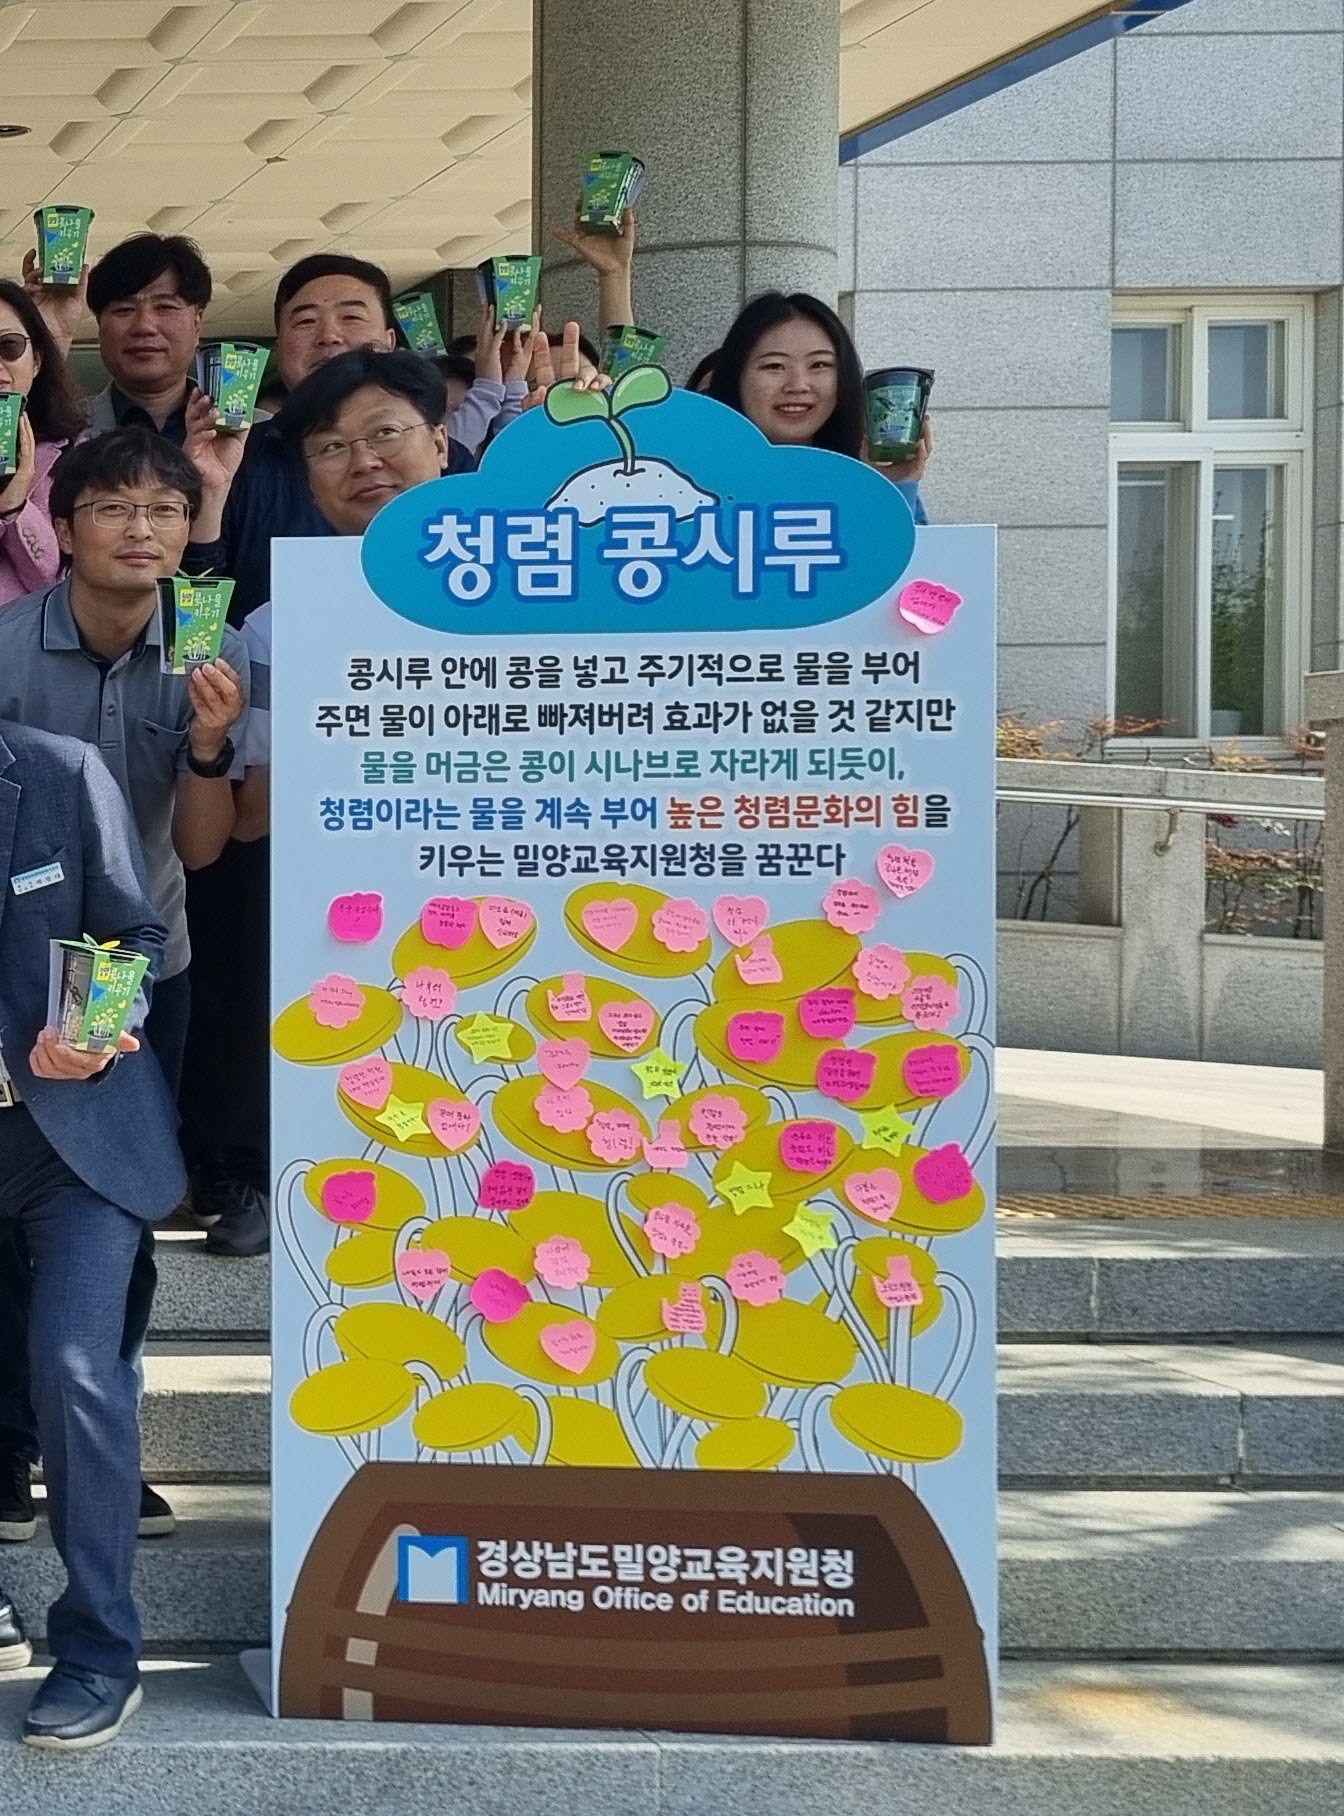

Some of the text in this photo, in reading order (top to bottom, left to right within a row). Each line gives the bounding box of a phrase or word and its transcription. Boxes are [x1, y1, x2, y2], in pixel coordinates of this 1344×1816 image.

[425, 508, 840, 598] 청렴 콩시루
[348, 651, 919, 690] 콩시루 안에 콩을 넣고 주기적으로 물을 부어
[316, 699, 956, 737] 주면 물이 아래로 빠져버려 효과가 없을 것 같지만
[361, 747, 904, 784] 물을 머금은 콩이 시나브로 자라게 되듯이,
[320, 794, 951, 831] 청렴이라는 물을 계속 부어 높은 청렴문화의 힘을
[420, 843, 846, 877] 키우는 밀양교육지원청을 꿈꾼다
[477, 1540, 854, 1590] 경상남도밀양교육지원청
[478, 1583, 855, 1617] Miryang Office of Education
